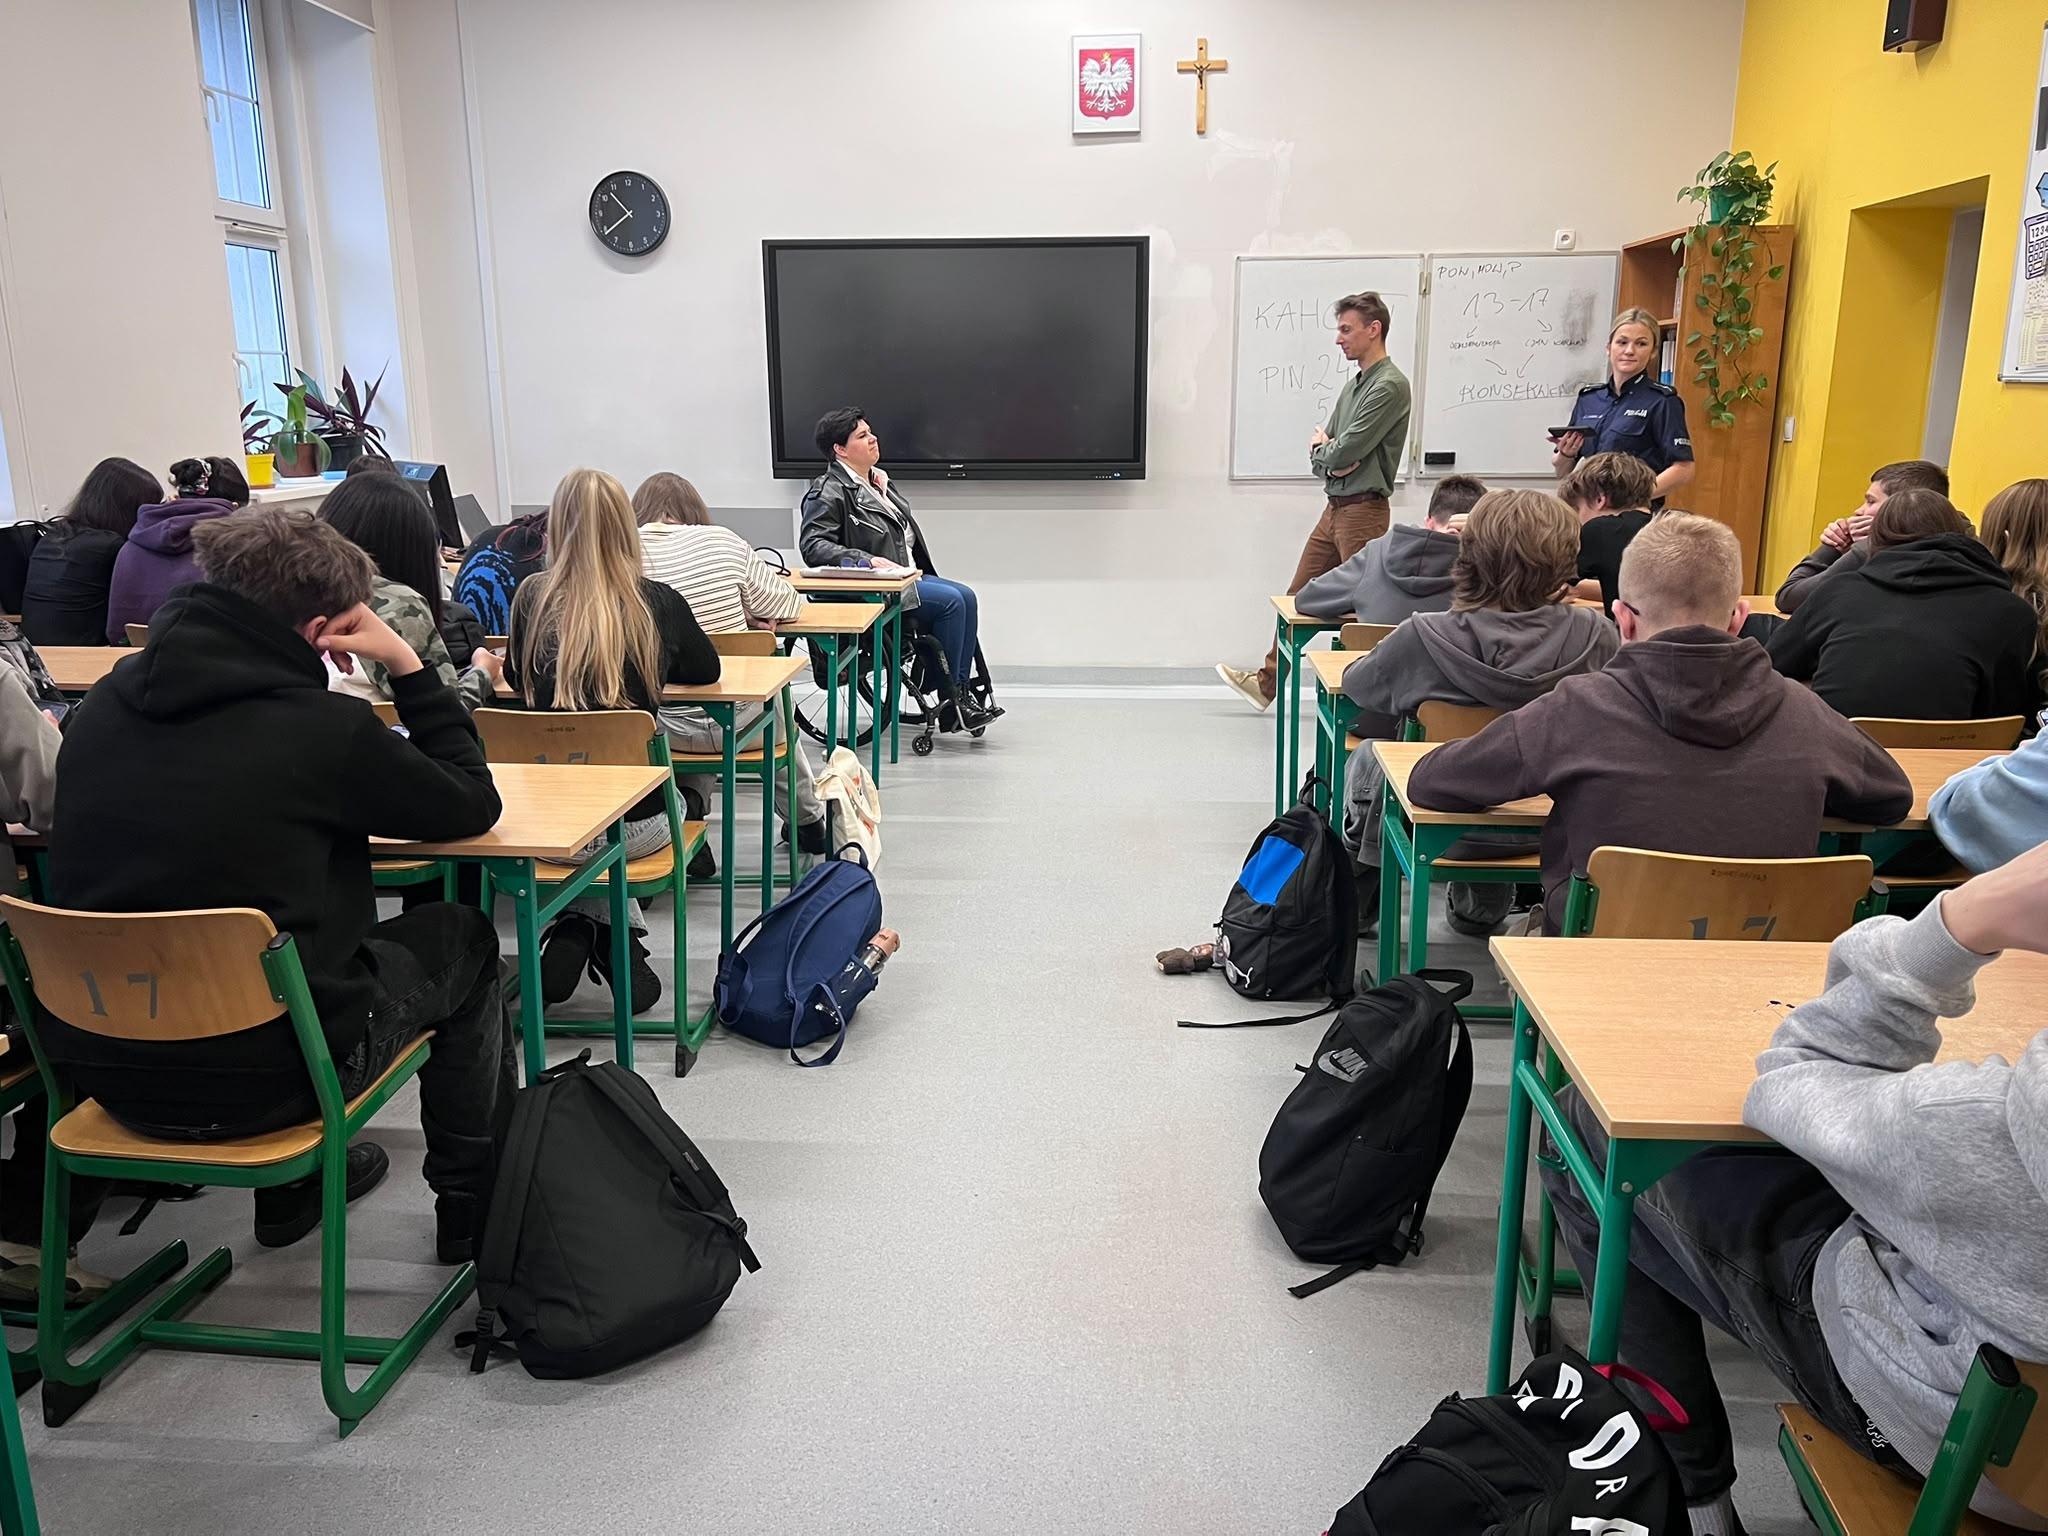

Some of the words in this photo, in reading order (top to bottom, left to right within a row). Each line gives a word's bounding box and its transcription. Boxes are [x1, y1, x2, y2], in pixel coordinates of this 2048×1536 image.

[1258, 364, 1305, 393] PIN
[1623, 409, 1648, 417] POLICJA
[80, 969, 159, 1019] 17
